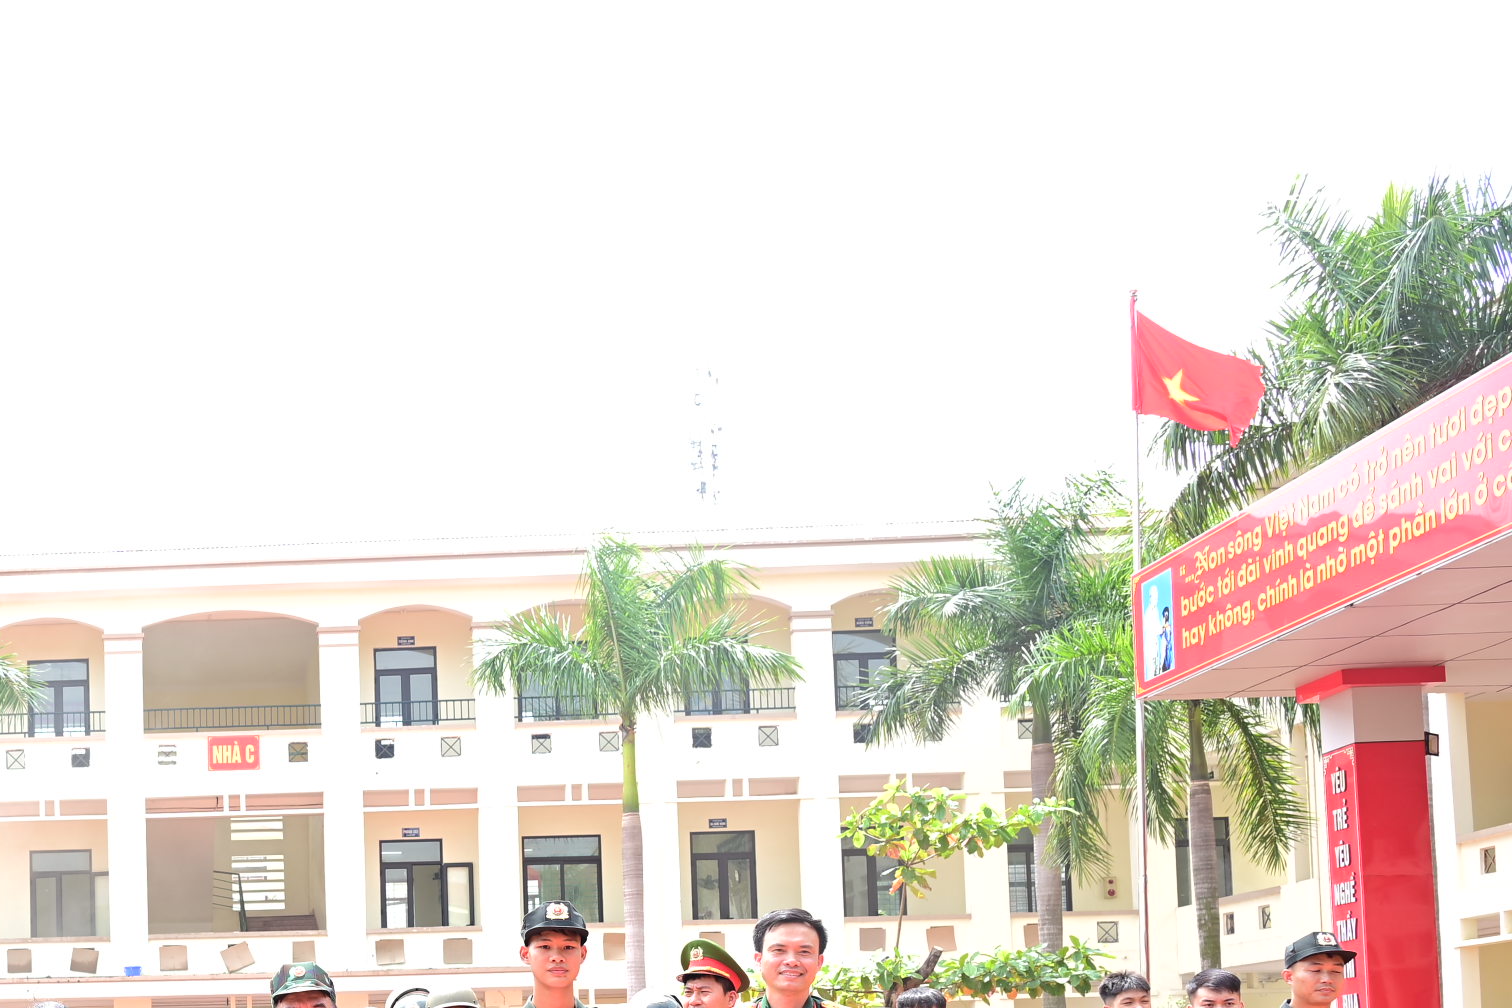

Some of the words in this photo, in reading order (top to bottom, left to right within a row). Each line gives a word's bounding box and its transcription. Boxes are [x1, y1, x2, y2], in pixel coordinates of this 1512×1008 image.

[1227, 525, 1263, 559] sông
[1264, 502, 1295, 538] Việt
[1299, 487, 1336, 518] Nam
[1338, 463, 1361, 498] có
[1364, 446, 1389, 485] trở
[1392, 434, 1427, 469] nên
[1429, 406, 1467, 449] tươi
[1470, 385, 1512, 426] đẹp
[1180, 582, 1215, 617] bước
[1217, 567, 1235, 598] tới
[1237, 556, 1261, 588] đài
[1263, 541, 1294, 574] vinh
[1296, 513, 1350, 560] quang
[1352, 486, 1376, 529] để
[1378, 472, 1424, 514] sánh
[1427, 451, 1458, 489] vai
[1461, 432, 1493, 471] với
[1181, 622, 1207, 649] hay
[1208, 600, 1255, 636] không,
[1257, 574, 1298, 612] chính
[1300, 563, 1315, 593] là
[1316, 546, 1347, 584] nhờ
[1350, 528, 1385, 568] một
[1389, 502, 1437, 554] phần
[1441, 488, 1471, 524] lớn
[1474, 472, 1489, 506] ở
[212, 740, 242, 764] NHÀ
[245, 744, 255, 763] C
[1331, 766, 1347, 795] YÊU
[1332, 798, 1349, 832] TRẺ
[1334, 840, 1351, 868] YÊU
[1334, 872, 1357, 906] NGHỀ
